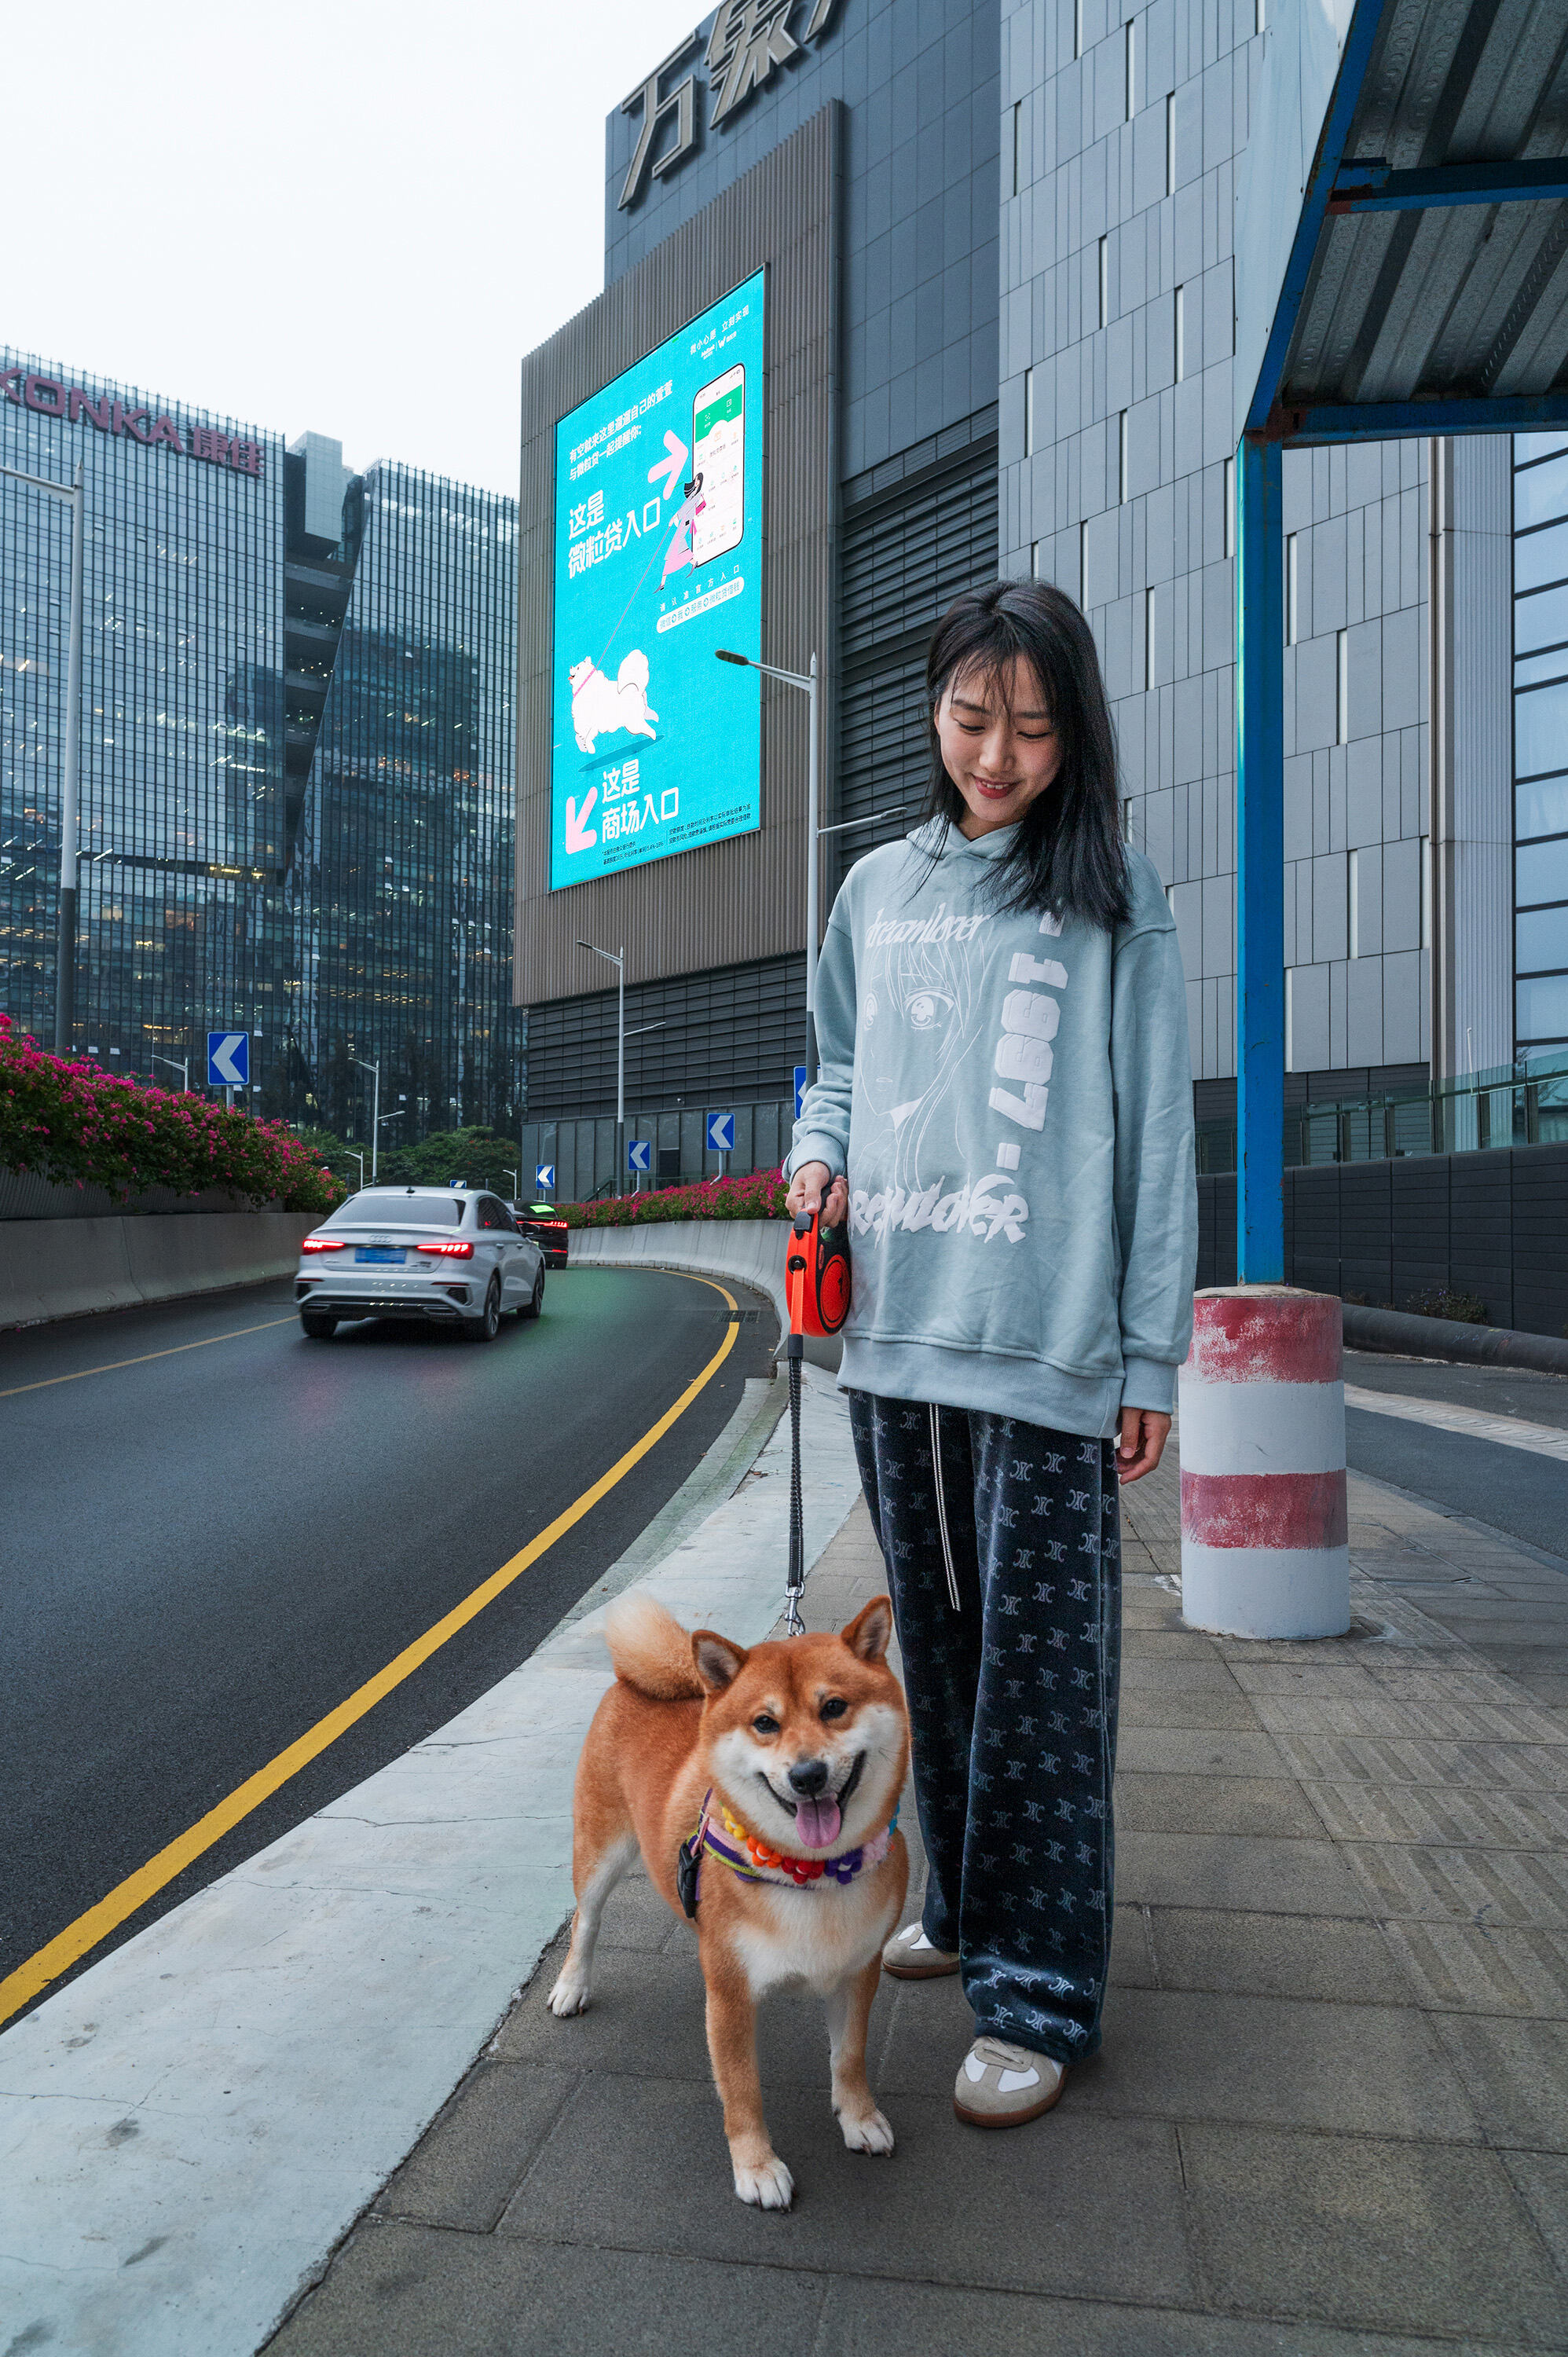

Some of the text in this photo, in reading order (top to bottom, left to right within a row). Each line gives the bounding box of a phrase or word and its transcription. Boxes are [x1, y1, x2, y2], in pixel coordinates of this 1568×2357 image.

[617, 0, 832, 211] 万象
[567, 497, 661, 579] 微粒贷入口
[568, 489, 604, 541] 这是
[602, 758, 640, 804] 这是
[602, 786, 680, 844] 商场入口
[866, 902, 991, 950] dreamlover
